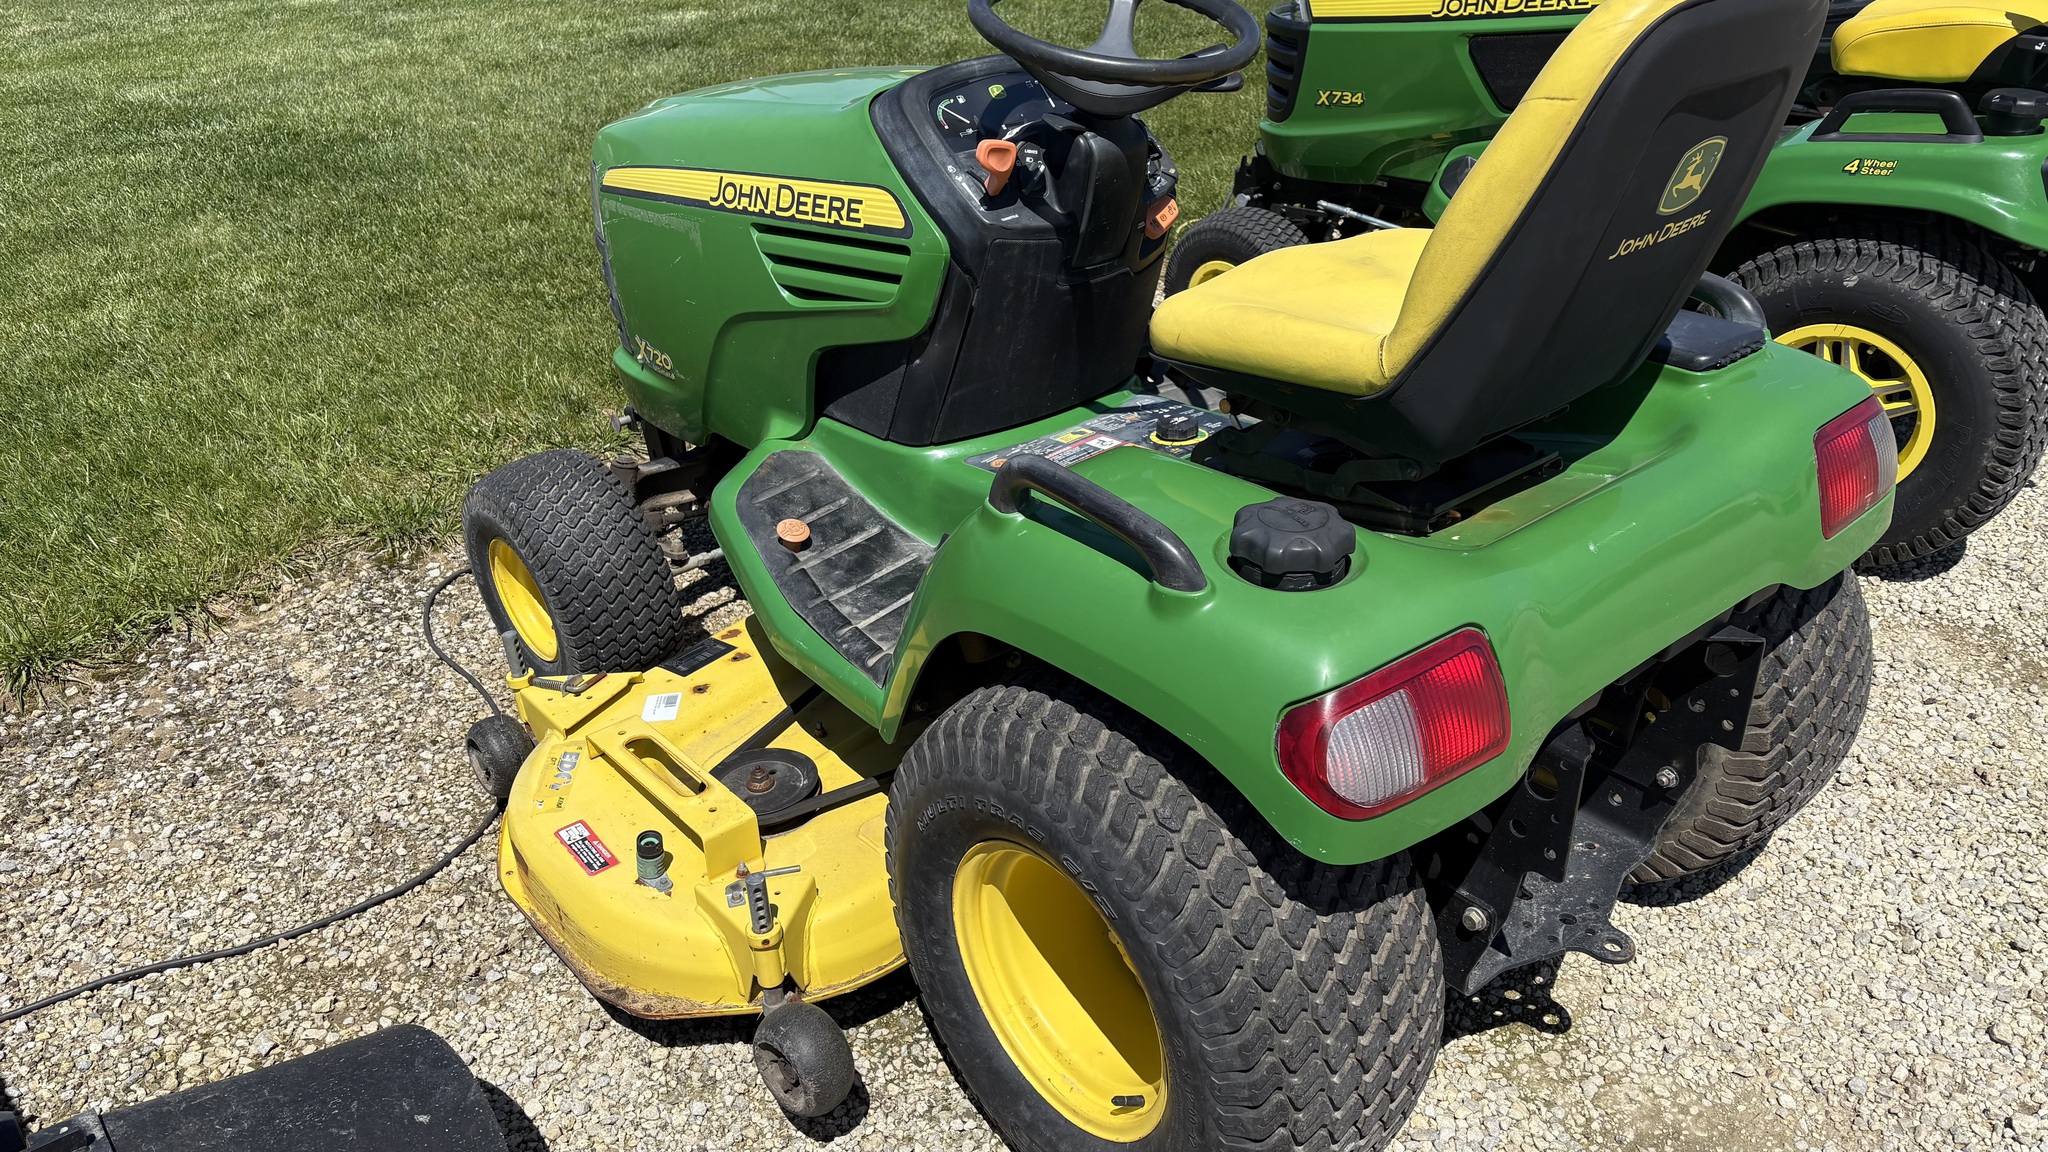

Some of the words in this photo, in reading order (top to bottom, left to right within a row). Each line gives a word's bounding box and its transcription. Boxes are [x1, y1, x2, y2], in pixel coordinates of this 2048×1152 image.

[1431, 0, 1498, 15] JOHN
[1316, 90, 1364, 106] X734
[1843, 158, 1860, 174] 4
[1860, 166, 1894, 176] Steer
[1863, 158, 1898, 168] Wheel
[709, 175, 771, 211] JOHN
[776, 183, 864, 224] DEERE
[1608, 230, 1660, 260] JOHN
[1657, 209, 1712, 243] DEERE
[635, 335, 673, 371] X720
[916, 796, 967, 833] MULTI
[974, 798, 1046, 843] TRAC
